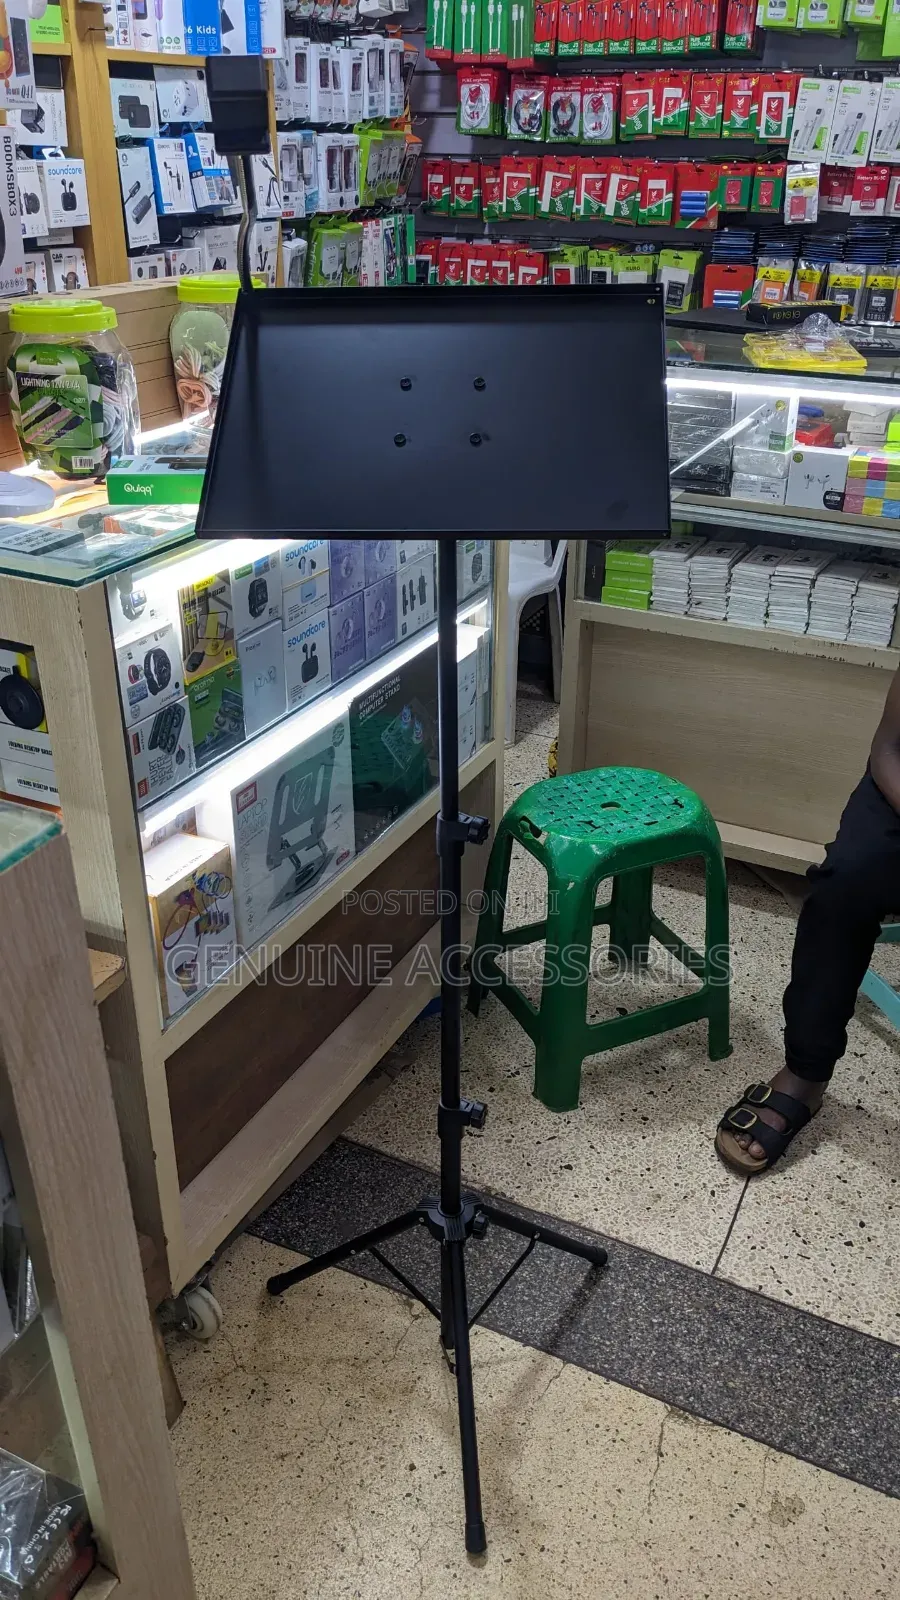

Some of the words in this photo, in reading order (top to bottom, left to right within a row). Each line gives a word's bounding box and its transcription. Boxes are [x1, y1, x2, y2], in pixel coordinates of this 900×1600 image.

[197, 25, 217, 35] Kids
[48, 164, 82, 176] soundcore
[20, 376, 51, 388] LIGHTNING
[124, 483, 153, 497] Quiqq
[287, 620, 326, 648] soundcore
[359, 695, 384, 720] COMPUTER
[385, 684, 401, 700] STAND
[44, 1505, 61, 1525] MADE
[38, 1525, 46, 1533] IN
[20, 1533, 40, 1555] CHINA
